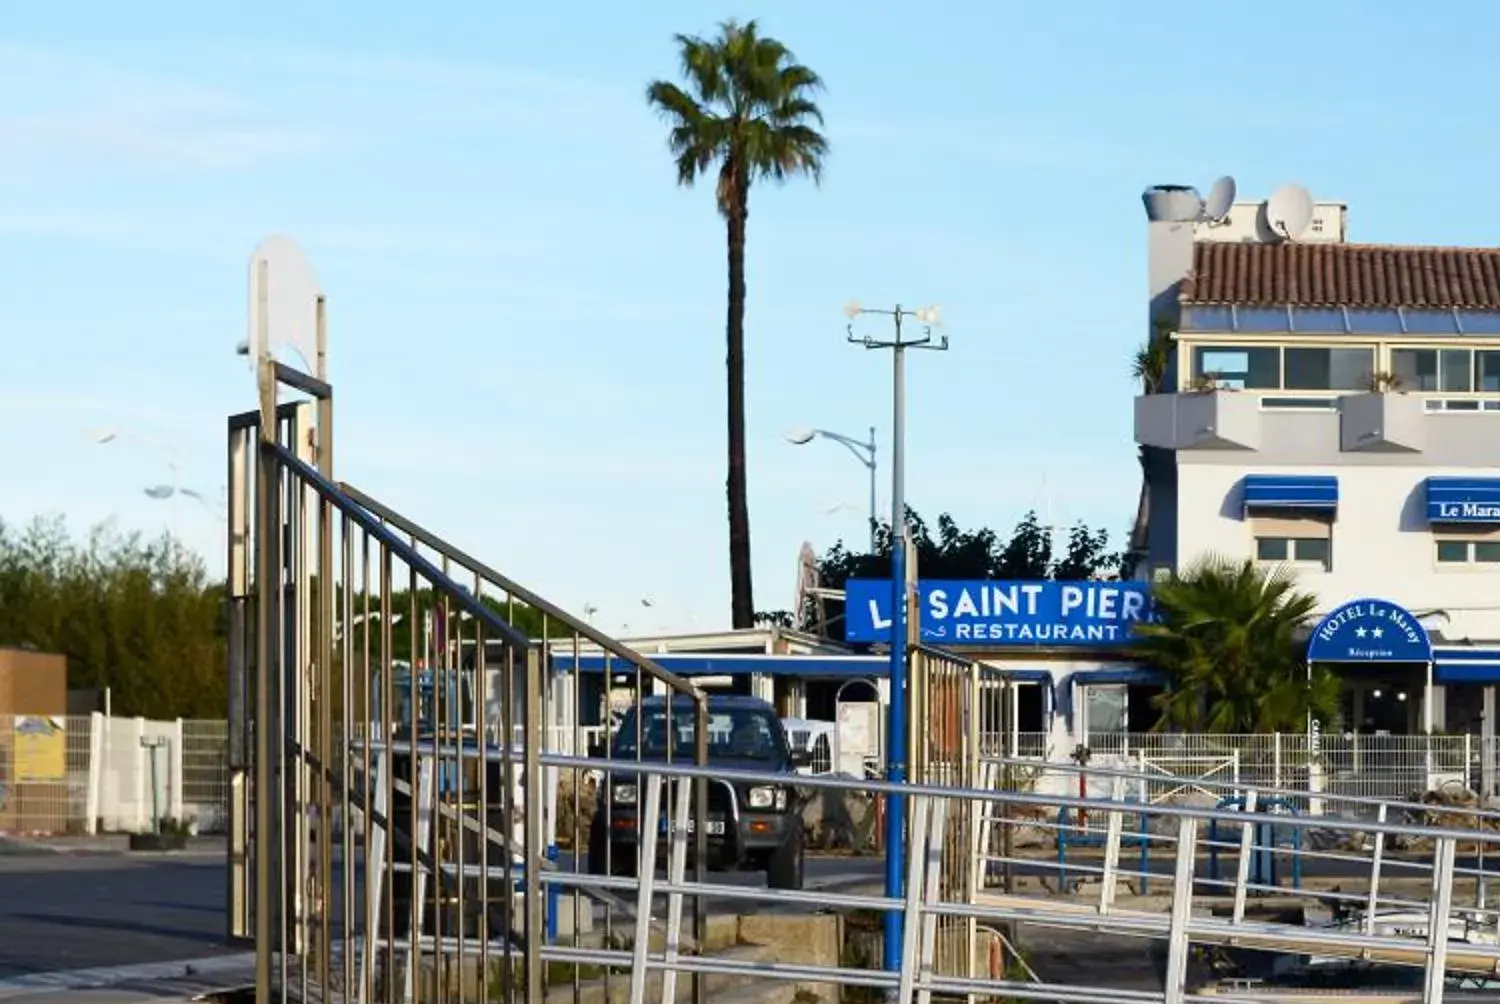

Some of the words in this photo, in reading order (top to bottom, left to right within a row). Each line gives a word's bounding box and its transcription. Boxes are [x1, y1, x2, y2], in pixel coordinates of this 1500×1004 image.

[1440, 504, 1458, 518] Le
[869, 591, 908, 629] L
[929, 585, 1043, 619] SAINT
[1061, 586, 1163, 623] PIER
[955, 623, 1119, 640] RESTAURANT
[1320, 605, 1366, 641] HOTEL
[1369, 603, 1386, 617] Le
[1389, 610, 1421, 643] Maray
